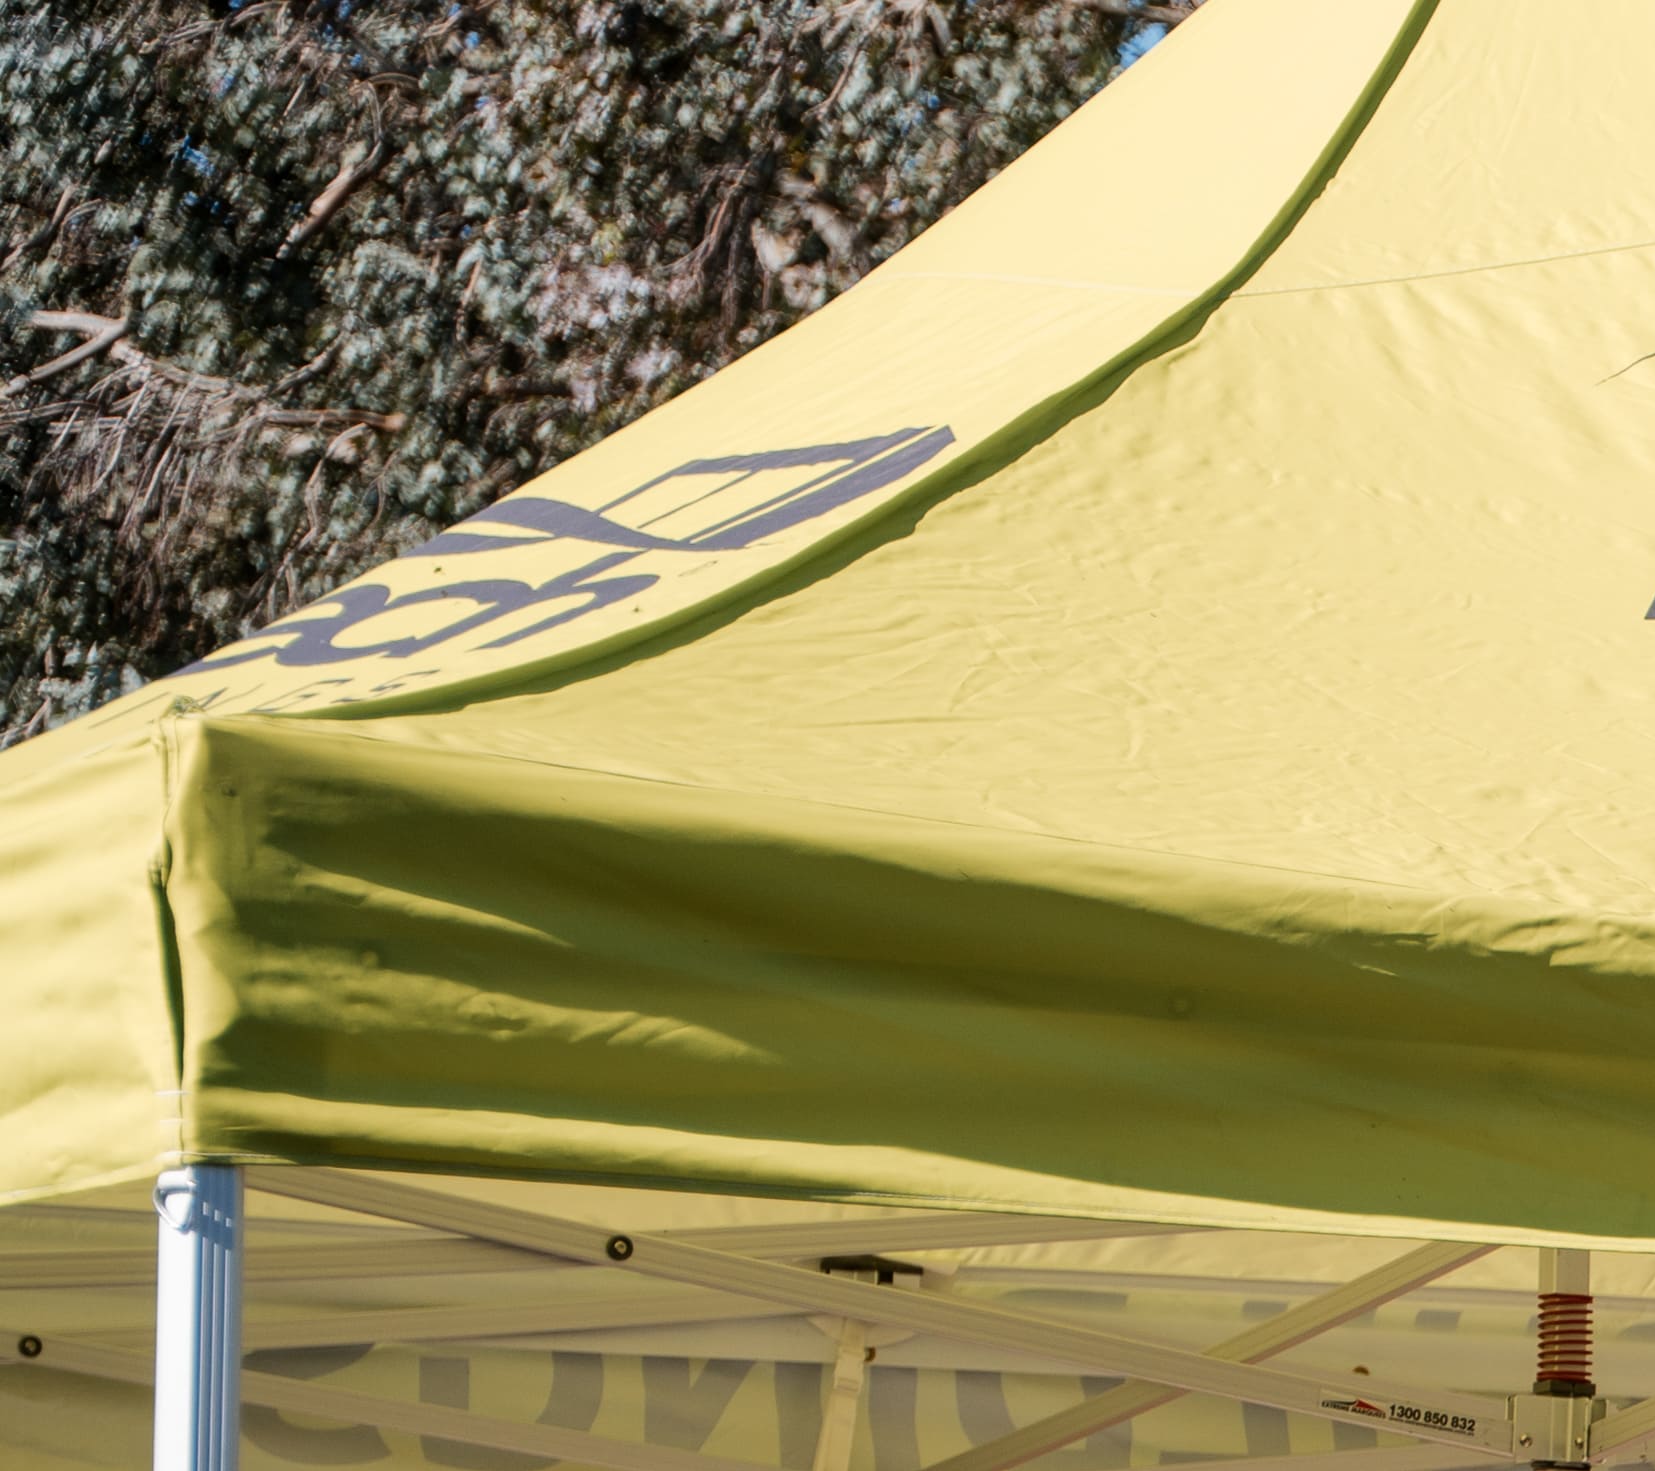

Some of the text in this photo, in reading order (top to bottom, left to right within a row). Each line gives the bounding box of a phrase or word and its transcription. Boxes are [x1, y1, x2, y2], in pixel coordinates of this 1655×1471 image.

[1389, 1404, 1421, 1421] 1300
[1424, 1410, 1448, 1426] 850
[1451, 1415, 1476, 1431] 832
